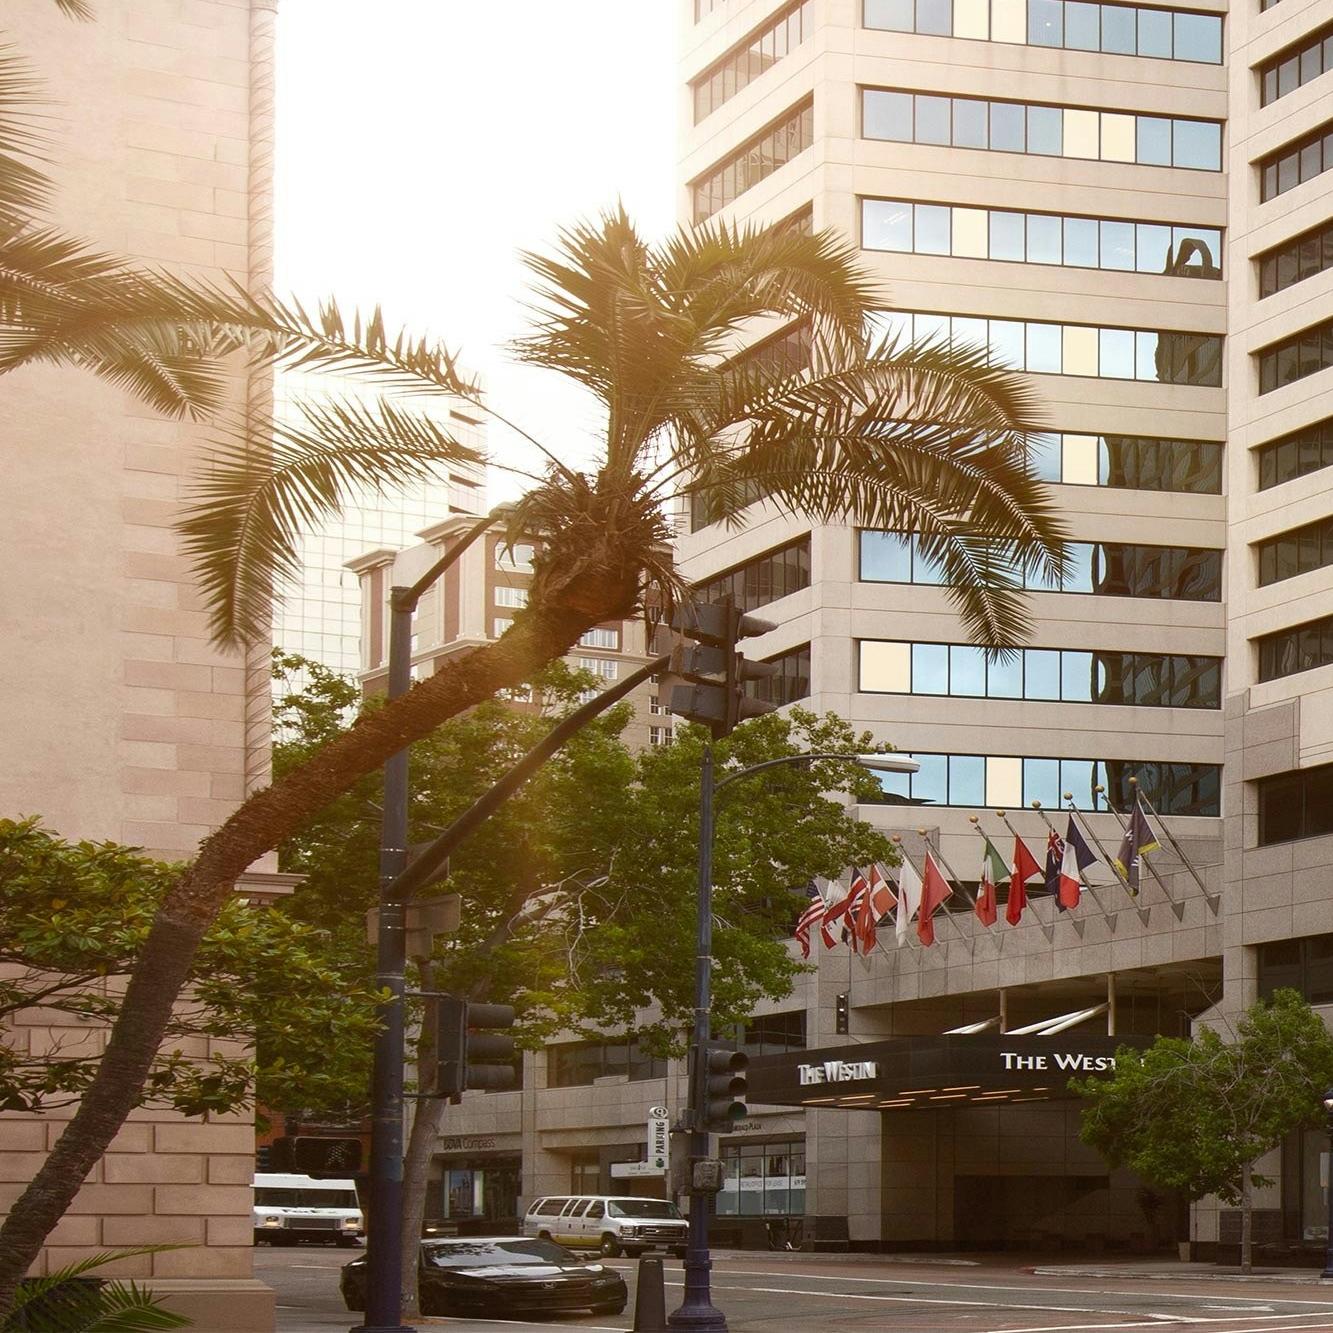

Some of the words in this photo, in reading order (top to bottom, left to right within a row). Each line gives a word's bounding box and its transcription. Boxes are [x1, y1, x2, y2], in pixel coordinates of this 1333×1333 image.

[797, 1064, 825, 1085] THE
[823, 1060, 877, 1082] WESTIN
[1000, 1052, 1048, 1070] THE
[1053, 1053, 1144, 1071] WEST
[463, 1138, 496, 1150] Compass
[655, 1121, 665, 1154] PARKING
